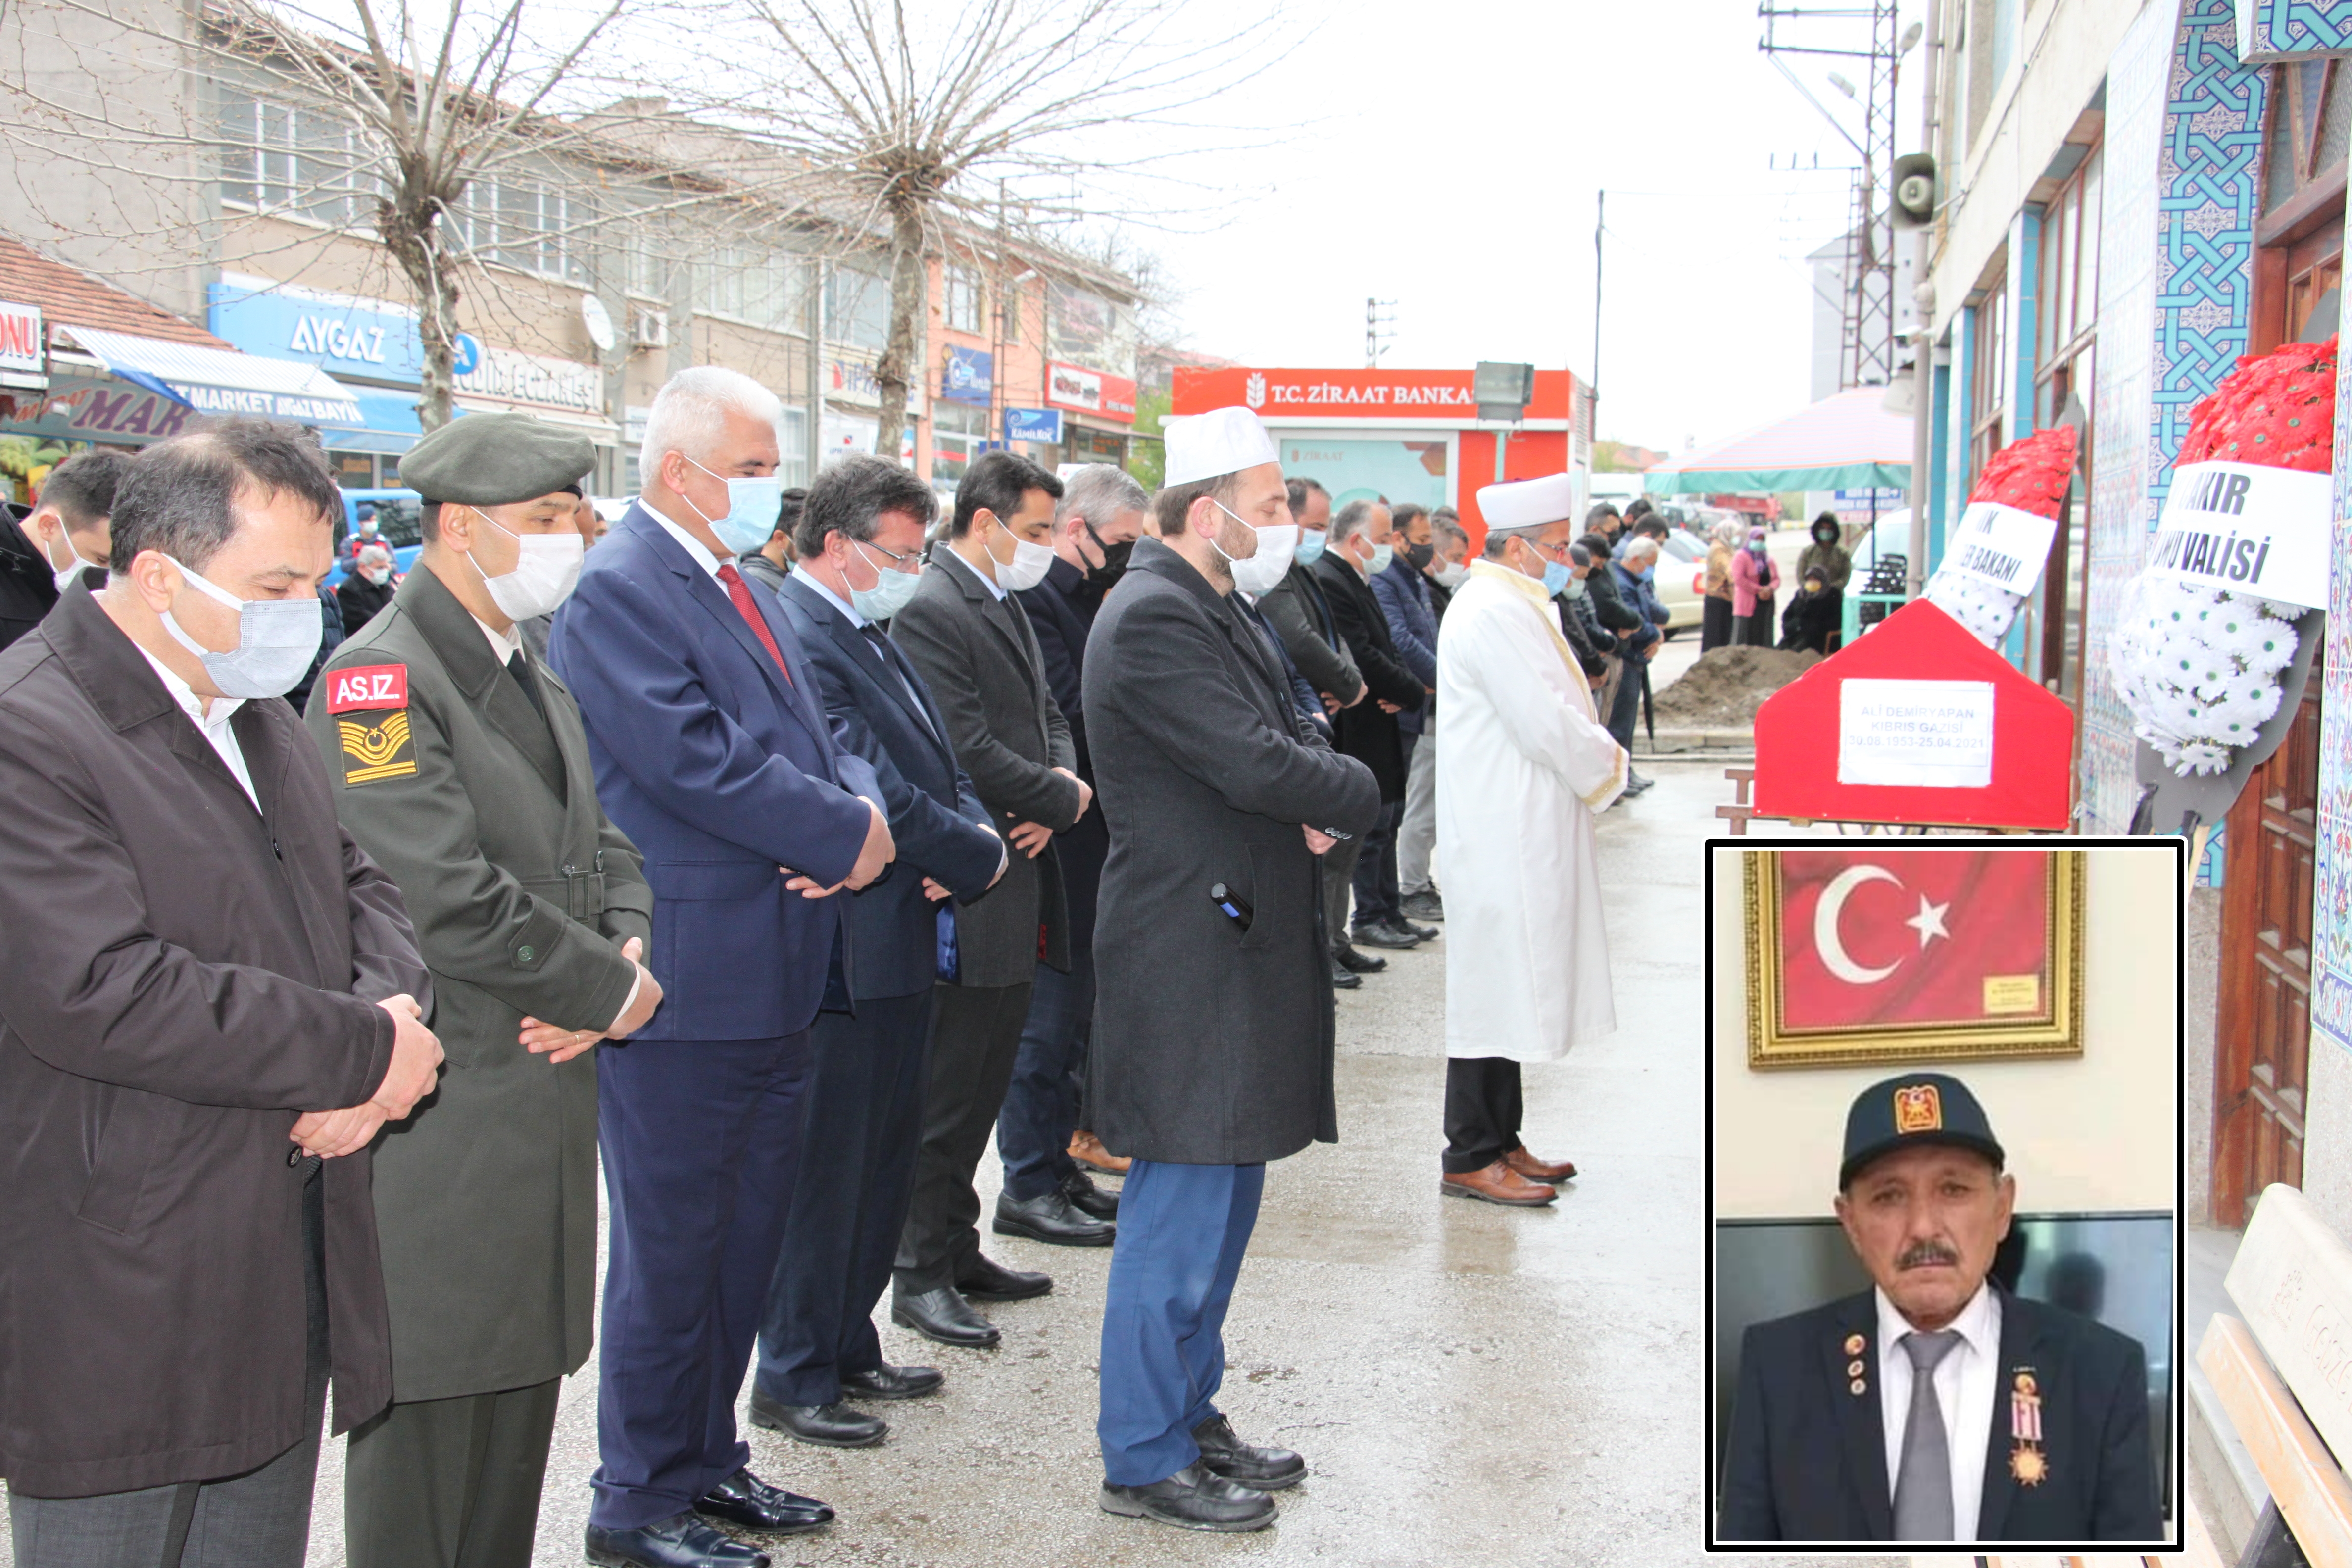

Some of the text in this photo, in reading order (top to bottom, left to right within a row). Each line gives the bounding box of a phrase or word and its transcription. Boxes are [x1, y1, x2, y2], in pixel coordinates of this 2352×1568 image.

[290, 315, 386, 363] AYGAZ
[190, 386, 274, 413] MARKET
[1272, 382, 1474, 404] T.C. ZİRAAT BANKA
[1971, 547, 2023, 583] BAKANI
[2180, 530, 2271, 584] VALİSİ
[1861, 704, 1882, 717] ALİ
[1871, 721, 1963, 734] KIBRIS GAZİSİ
